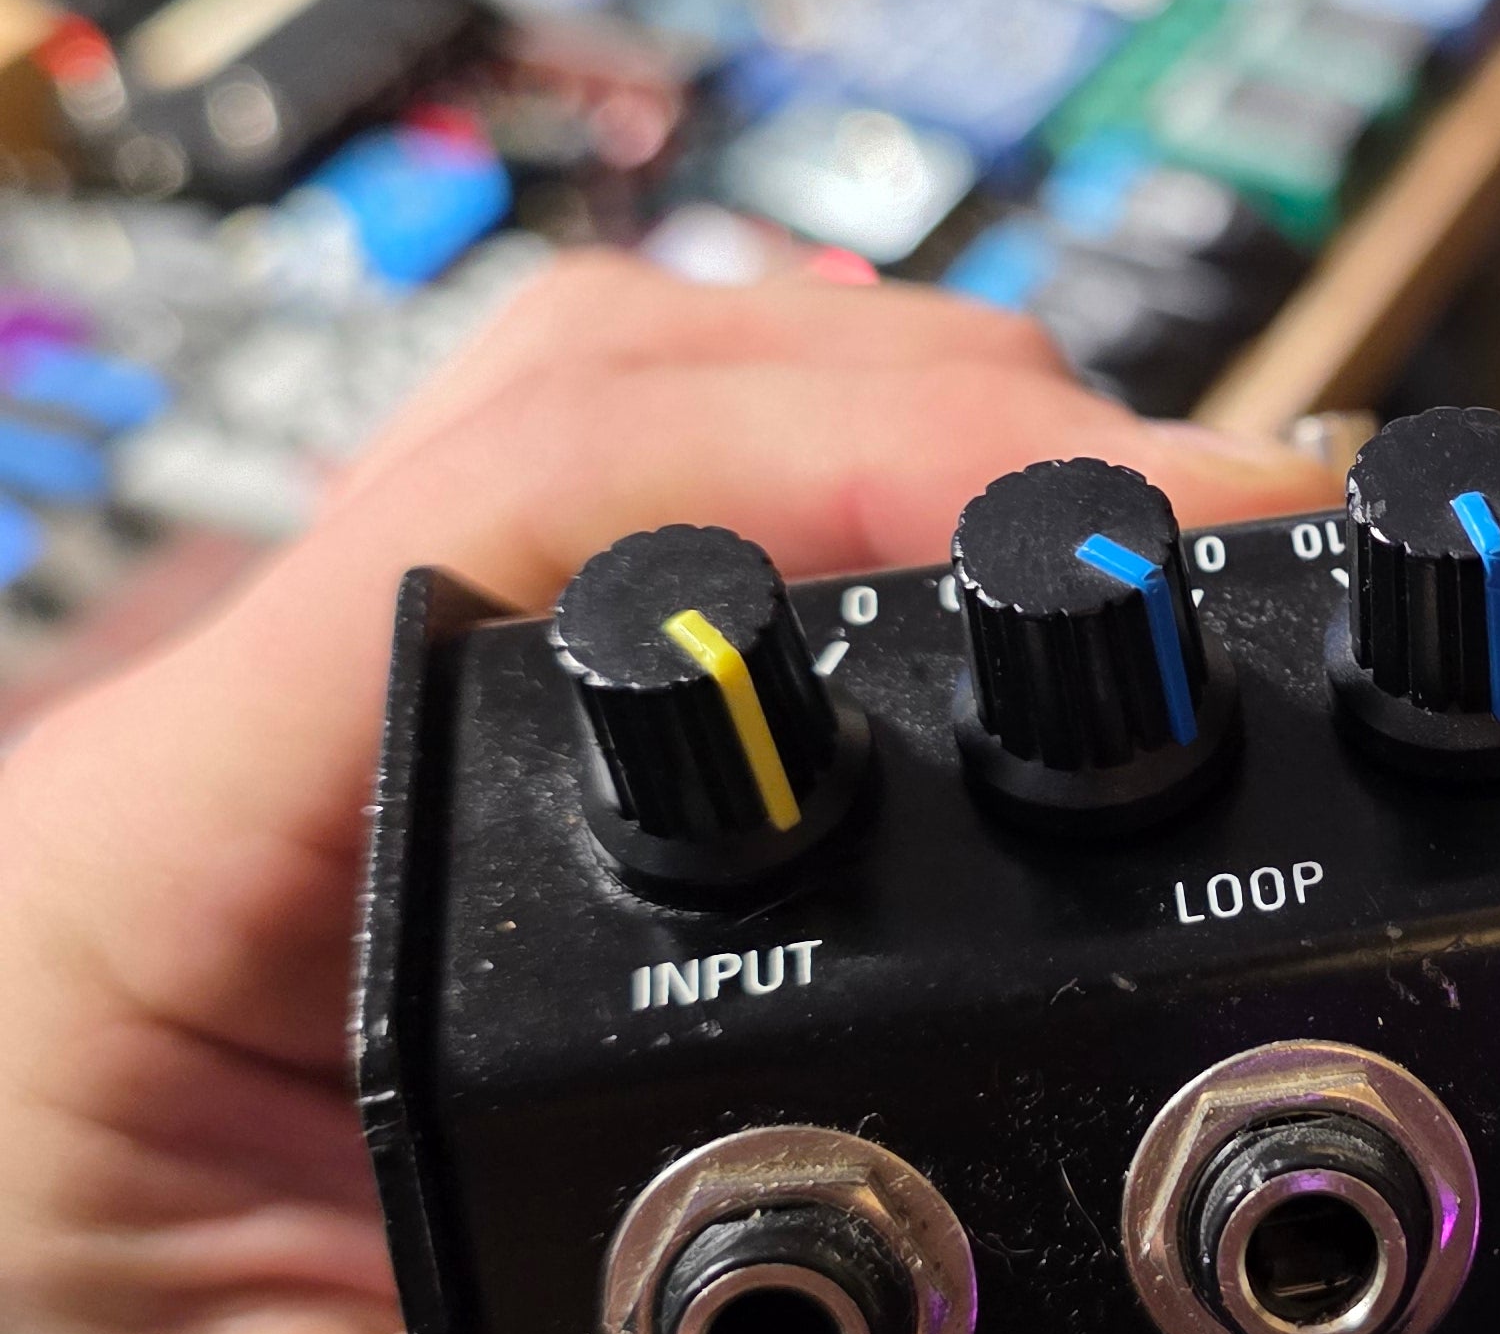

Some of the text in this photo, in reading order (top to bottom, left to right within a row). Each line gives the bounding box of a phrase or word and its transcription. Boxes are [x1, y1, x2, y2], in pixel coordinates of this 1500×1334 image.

[1194, 535, 1226, 573] 0
[1291, 520, 1346, 561] 10
[841, 585, 878, 626] 0
[1174, 860, 1324, 924] LOOP
[631, 939, 823, 1012] INPUT
